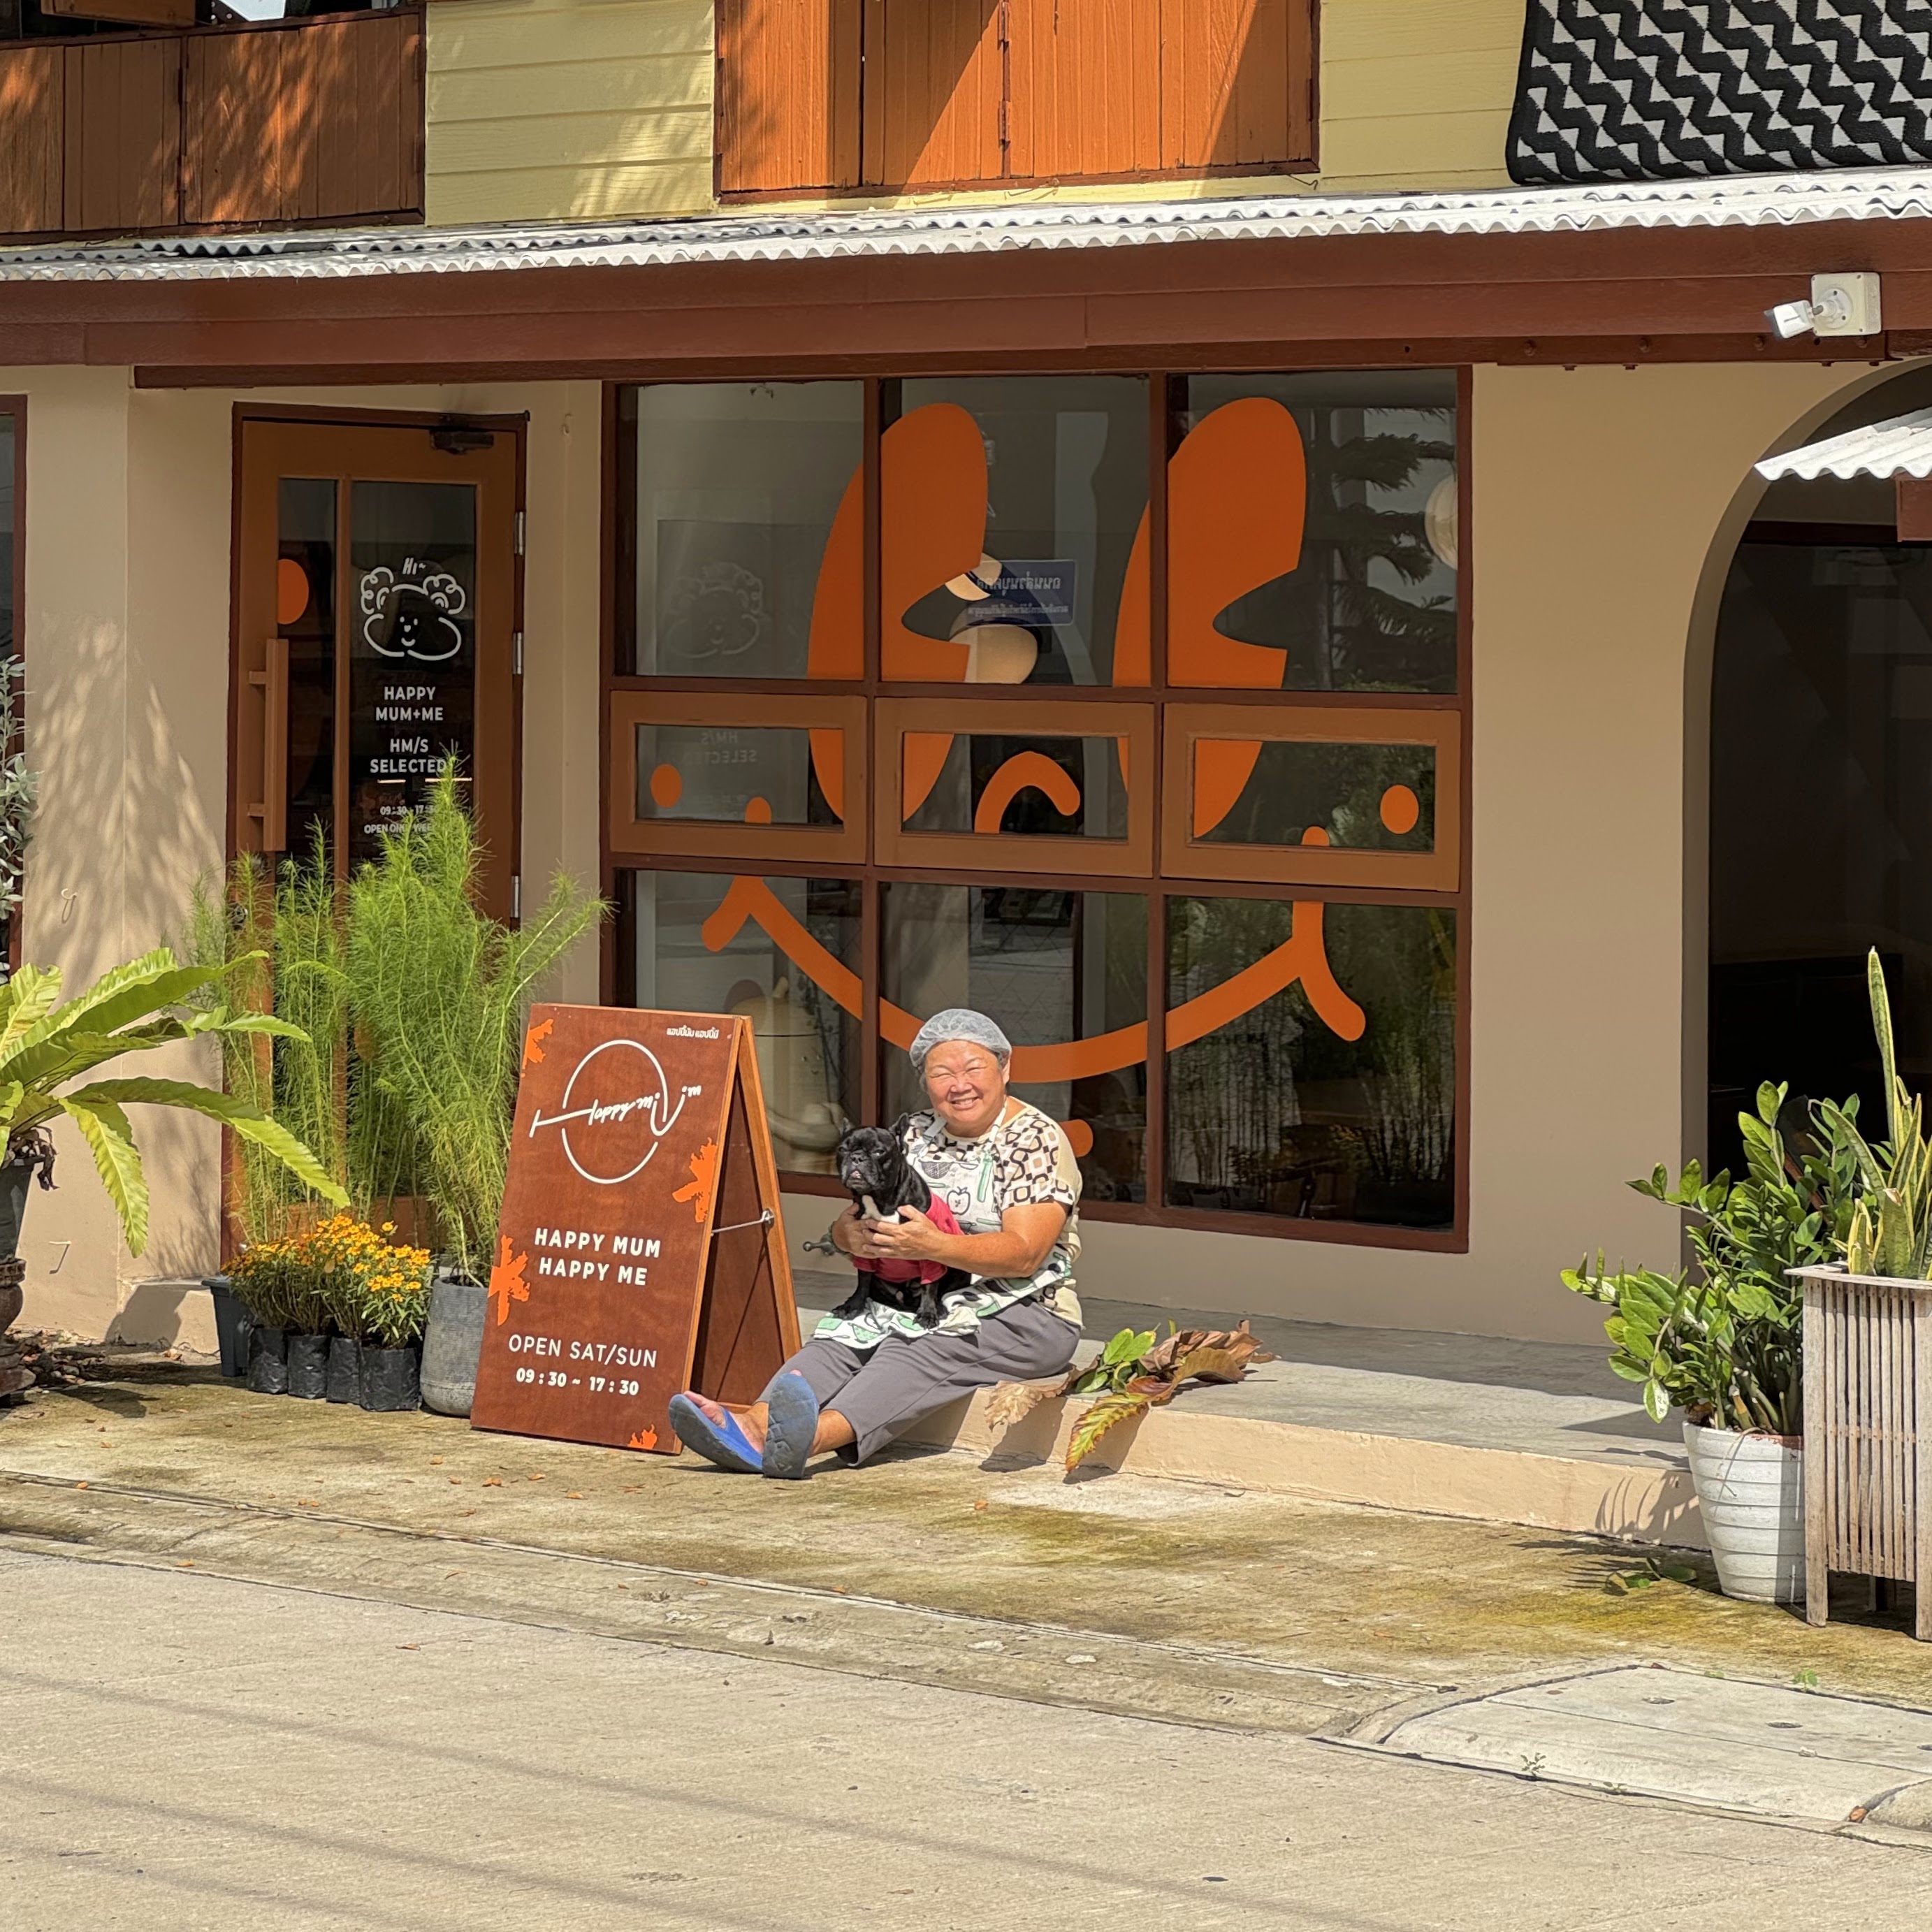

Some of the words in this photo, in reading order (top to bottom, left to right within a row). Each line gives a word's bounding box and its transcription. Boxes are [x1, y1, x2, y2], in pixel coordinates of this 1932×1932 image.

[384, 686, 436, 701] HAPPY
[375, 706, 444, 721] MUM+ME
[389, 736, 429, 755] HM/S
[370, 759, 446, 773] SELECTED
[363, 823, 388, 834] OPEN
[534, 1227, 606, 1252] HAPPY
[612, 1235, 661, 1258] MUM
[538, 1256, 610, 1281] HAPPY
[617, 1265, 648, 1286] ME
[509, 1334, 562, 1357] OPEN
[569, 1341, 658, 1368] SAT/SUN
